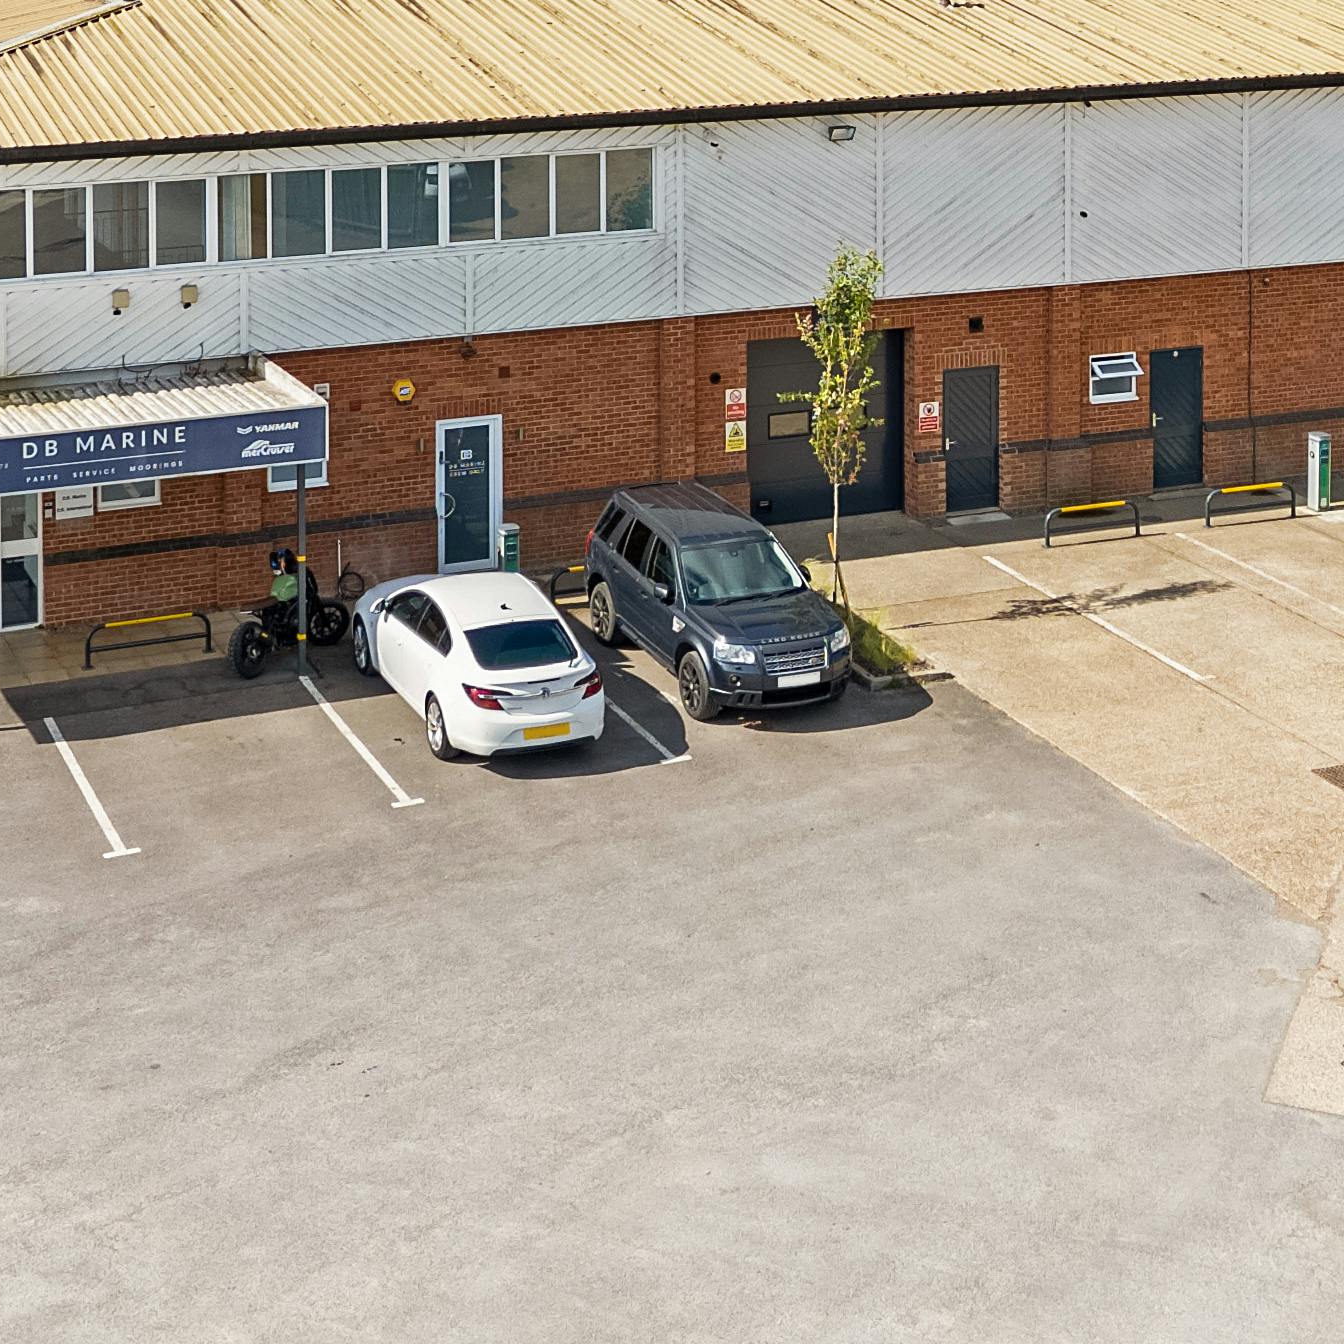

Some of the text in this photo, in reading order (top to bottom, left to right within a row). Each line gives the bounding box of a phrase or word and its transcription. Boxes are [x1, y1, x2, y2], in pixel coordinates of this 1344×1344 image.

[254, 421, 300, 433] YANMAR
[22, 426, 187, 459] DB MARINE
[26, 460, 184, 484] PARTS SERVICE MOORINGS
[761, 632, 821, 644] LAND ROVER
